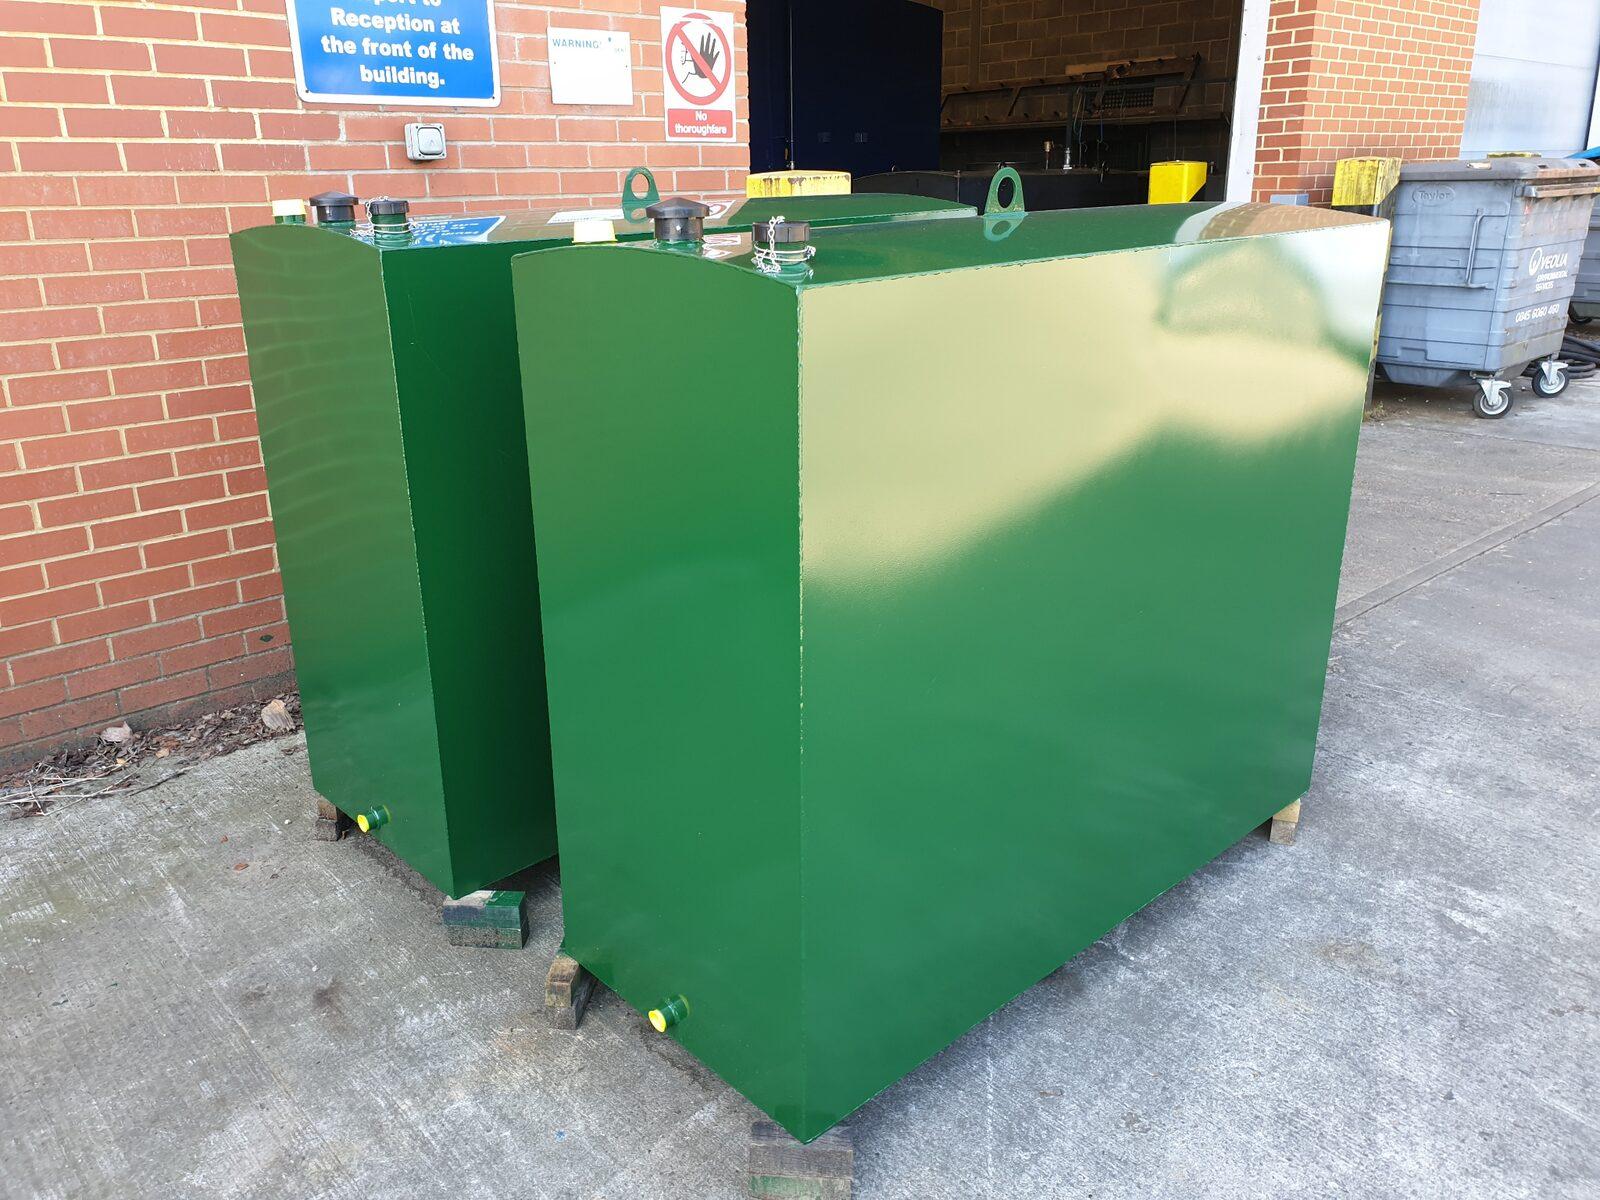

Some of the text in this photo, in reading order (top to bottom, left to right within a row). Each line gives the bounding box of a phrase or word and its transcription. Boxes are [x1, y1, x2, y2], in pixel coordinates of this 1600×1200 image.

[330, 8, 461, 34] Reception at
[321, 35, 475, 61] the front of the
[359, 64, 445, 89] building.
[695, 110, 708, 121] No
[675, 122, 727, 136] thoroughfare
[1418, 189, 1450, 200] Taylor
[1541, 252, 1568, 270] VEOLIA
